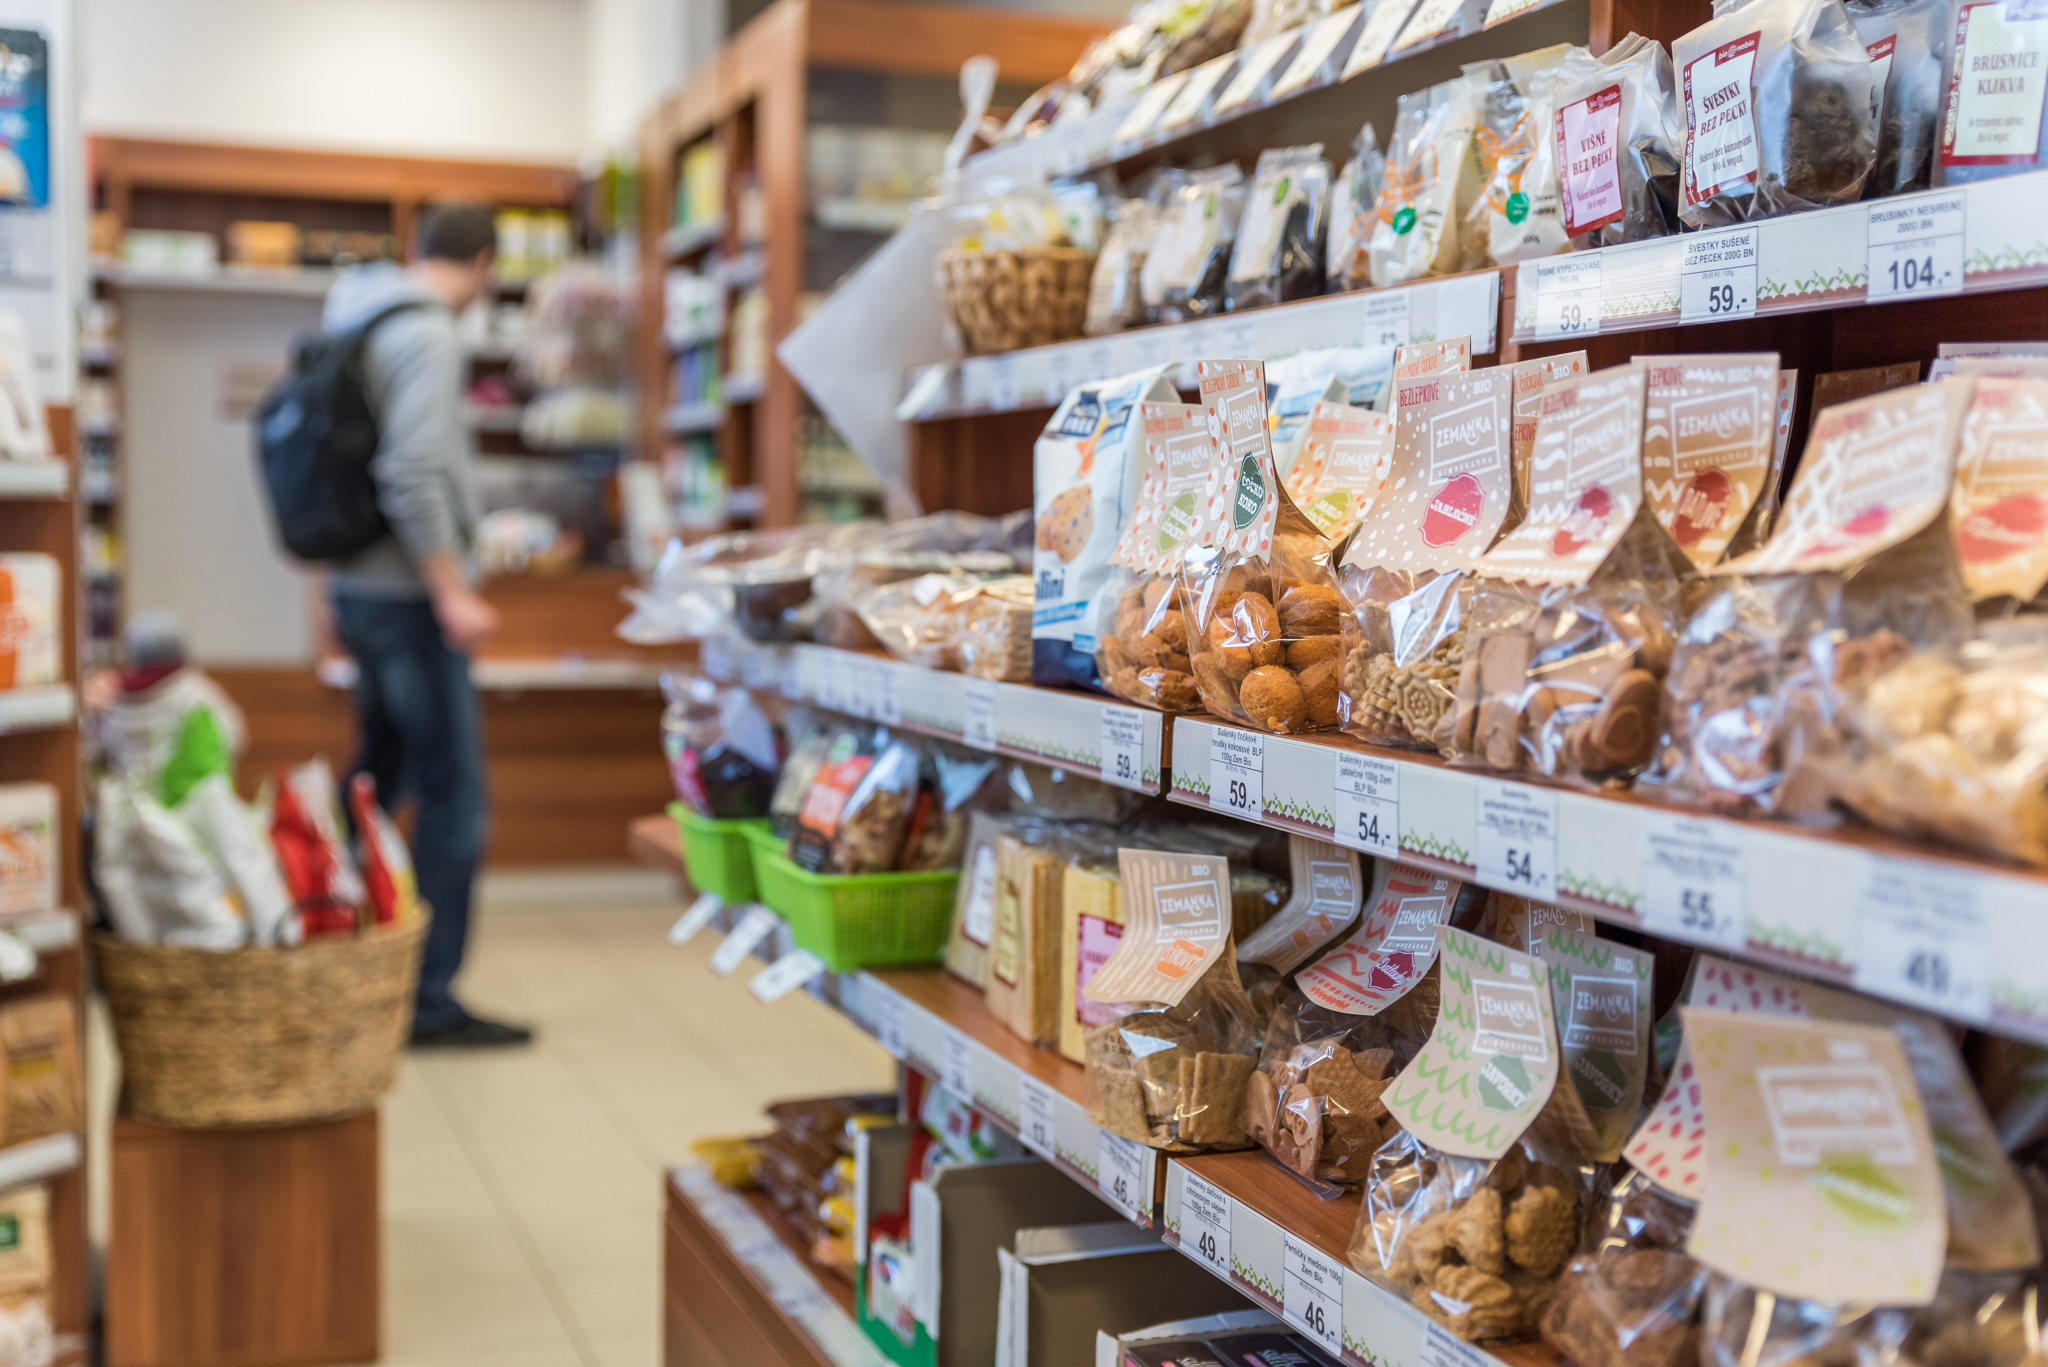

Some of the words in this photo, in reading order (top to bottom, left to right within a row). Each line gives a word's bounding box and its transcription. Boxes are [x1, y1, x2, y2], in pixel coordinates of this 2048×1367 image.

[1971, 51, 2040, 72] BRUSNICE
[1702, 79, 1742, 115] ŠVESTKY
[1976, 76, 2025, 96] KLIKVA
[1700, 112, 1717, 137] BEZ
[1718, 98, 1748, 128] PECKY
[1580, 129, 1606, 152] VIŠNĚ
[1572, 157, 1589, 176] BEZ
[1592, 146, 1613, 169] PECKY
[1870, 207, 1914, 224] BRUSINKY
[1917, 200, 1962, 216] NESIRENE
[1897, 220, 1918, 233] 200G
[1920, 218, 1934, 230] BN
[1688, 240, 1720, 254] ŠVESTKY
[1721, 234, 1750, 249] SUŠENÉ
[1684, 255, 1698, 266] BEZ
[1700, 252, 1723, 264] PECEK
[1724, 250, 1742, 260] 200G
[1744, 248, 1754, 258] BN
[1888, 256, 1952, 290] 104,-
[1709, 284, 1747, 314] 59,-
[1560, 304, 1593, 332] 59,-
[1444, 348, 1458, 362] BIO
[1202, 371, 1226, 394] BEZLEPKOVÉ
[1226, 369, 1240, 390] ČOČKOVÉ
[1244, 370, 1254, 382] BIO
[1520, 371, 1544, 392] ČOČKOVÉ
[1553, 364, 1570, 380] BIO
[1727, 367, 1752, 383] BIO
[1399, 378, 1440, 408] BEZLEPKOVÉ
[1473, 379, 1492, 394] BIO
[1191, 415, 1206, 427] BIO
[1232, 403, 1258, 430] ZEMANKA
[1514, 416, 1538, 442] EPKOVÉ
[1678, 406, 1751, 438] ZEMANKA
[1436, 416, 1492, 446] ZEMANKA
[1572, 418, 1625, 456] ZEMANKA
[1171, 444, 1210, 469] ZEMANKA
[1242, 472, 1263, 498] ČOČKO
[1238, 492, 1258, 514] KOKO
[1430, 498, 1478, 527] JABLEČNÉ
[1212, 738, 1227, 750] hrudky
[1228, 742, 1250, 754] kokosové
[1252, 746, 1262, 756] BLP
[1218, 728, 1236, 741] Sušenky
[1237, 731, 1257, 744] čočkové
[1222, 752, 1232, 764] 100g
[1233, 754, 1242, 764] Zem
[1244, 756, 1252, 766] Bio
[1339, 752, 1362, 768] Sušenky
[1340, 766, 1363, 780] jablečné
[1365, 772, 1378, 785] 100g
[1380, 774, 1392, 785] Zem
[1229, 780, 1256, 812] 59,-
[1354, 782, 1366, 792] BLP
[1367, 785, 1377, 796] Bio
[1358, 812, 1390, 848] 54,-
[1190, 864, 1211, 877] BIO
[1506, 848, 1547, 885] 54,-
[1434, 880, 1448, 891] BIO
[1160, 893, 1215, 918] ZEMANKA
[1398, 908, 1438, 932] ZEMANKA
[1510, 962, 1530, 980] BIO
[1614, 956, 1634, 974] BIO
[1479, 995, 1537, 1028] ZEMANKA
[1576, 992, 1632, 1022] ZEMANKA
[1482, 1062, 1531, 1110] JAVORKY
[1188, 1174, 1206, 1193] Sušenky
[1206, 1186, 1222, 1202] datlové
[1186, 1186, 1210, 1206] citrónovým
[1211, 1201, 1226, 1216] olejem
[1191, 1200, 1201, 1212] 100g
[1202, 1206, 1212, 1218] Zem
[1212, 1213, 1220, 1224] Bio
[1199, 1231, 1224, 1268] 49,-
[1301, 1263, 1313, 1278] Zem
[1314, 1271, 1323, 1284] Bio
[1307, 1256, 1328, 1274] medové
[1329, 1268, 1342, 1286] 100g
[1305, 1301, 1335, 1342] 46,-
